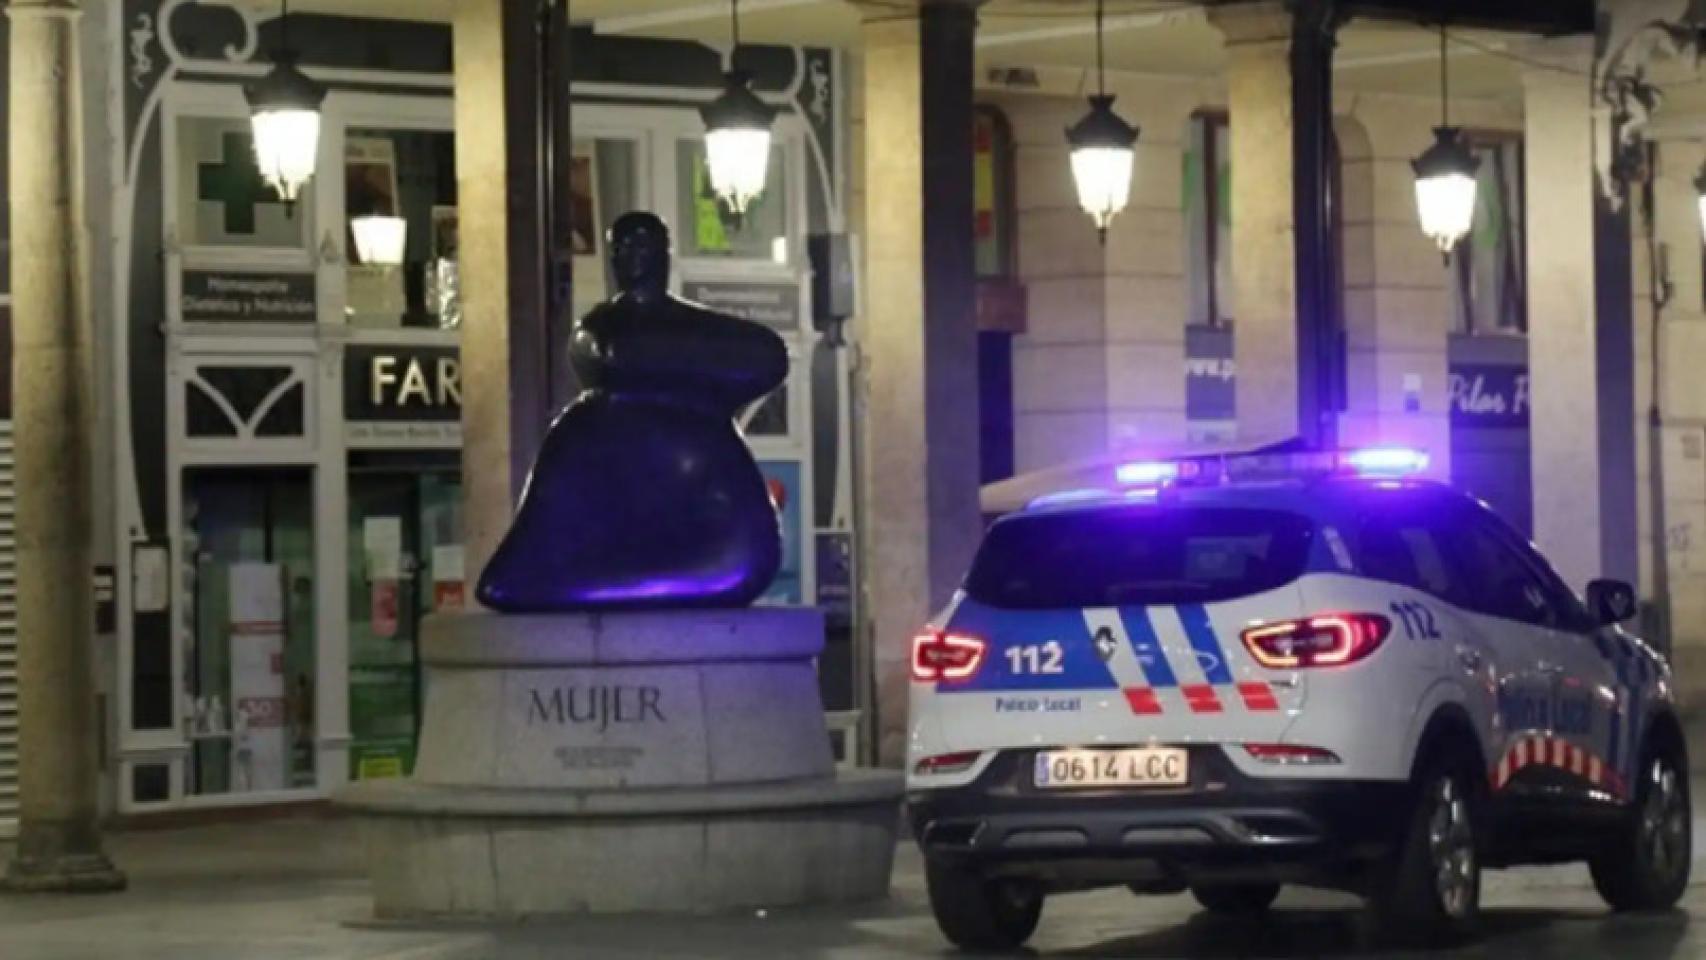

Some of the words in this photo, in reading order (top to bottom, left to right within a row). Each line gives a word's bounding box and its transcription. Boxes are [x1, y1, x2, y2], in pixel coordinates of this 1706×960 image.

[372, 356, 462, 405] FAR
[1390, 601, 1441, 640] 112
[1004, 641, 1064, 675] 112
[528, 687, 667, 734] MUJER
[1052, 757, 1119, 781] 0614
[1129, 754, 1180, 780] LCC
